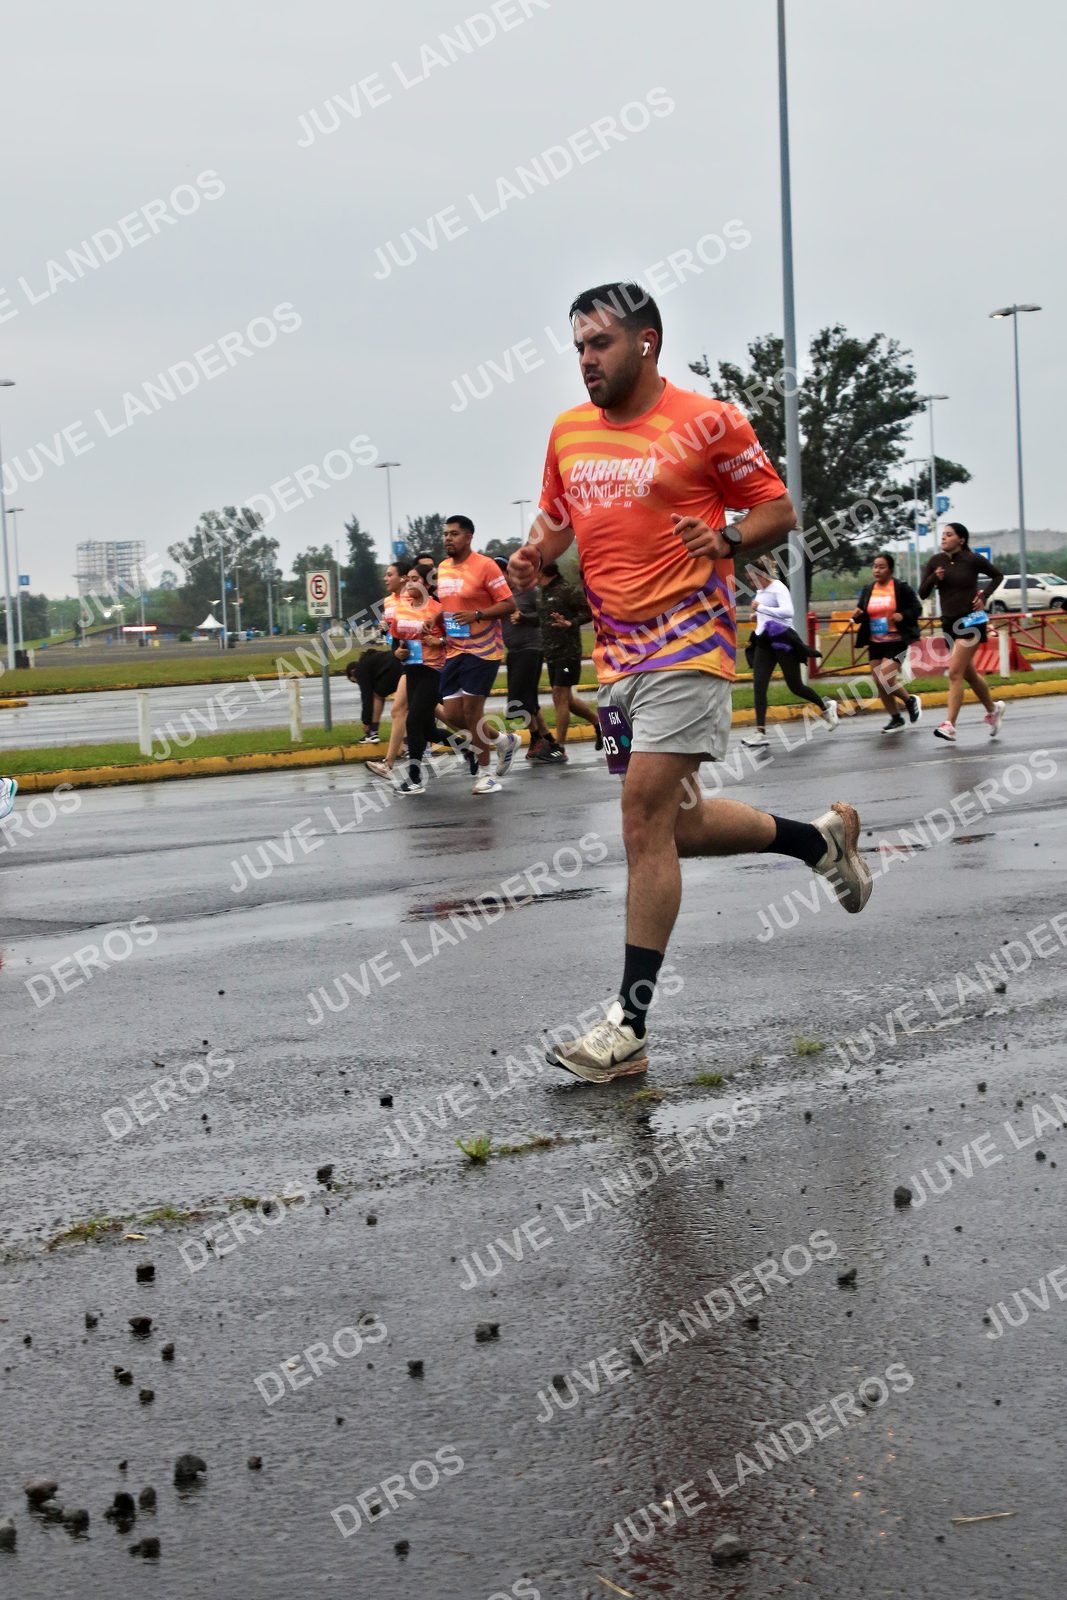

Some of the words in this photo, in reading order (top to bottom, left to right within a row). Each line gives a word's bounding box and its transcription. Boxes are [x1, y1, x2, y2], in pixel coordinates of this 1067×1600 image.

[570, 457, 656, 482] CARRERA
[570, 483, 632, 499] OMNILIFE
[608, 711, 622, 725] 15K
